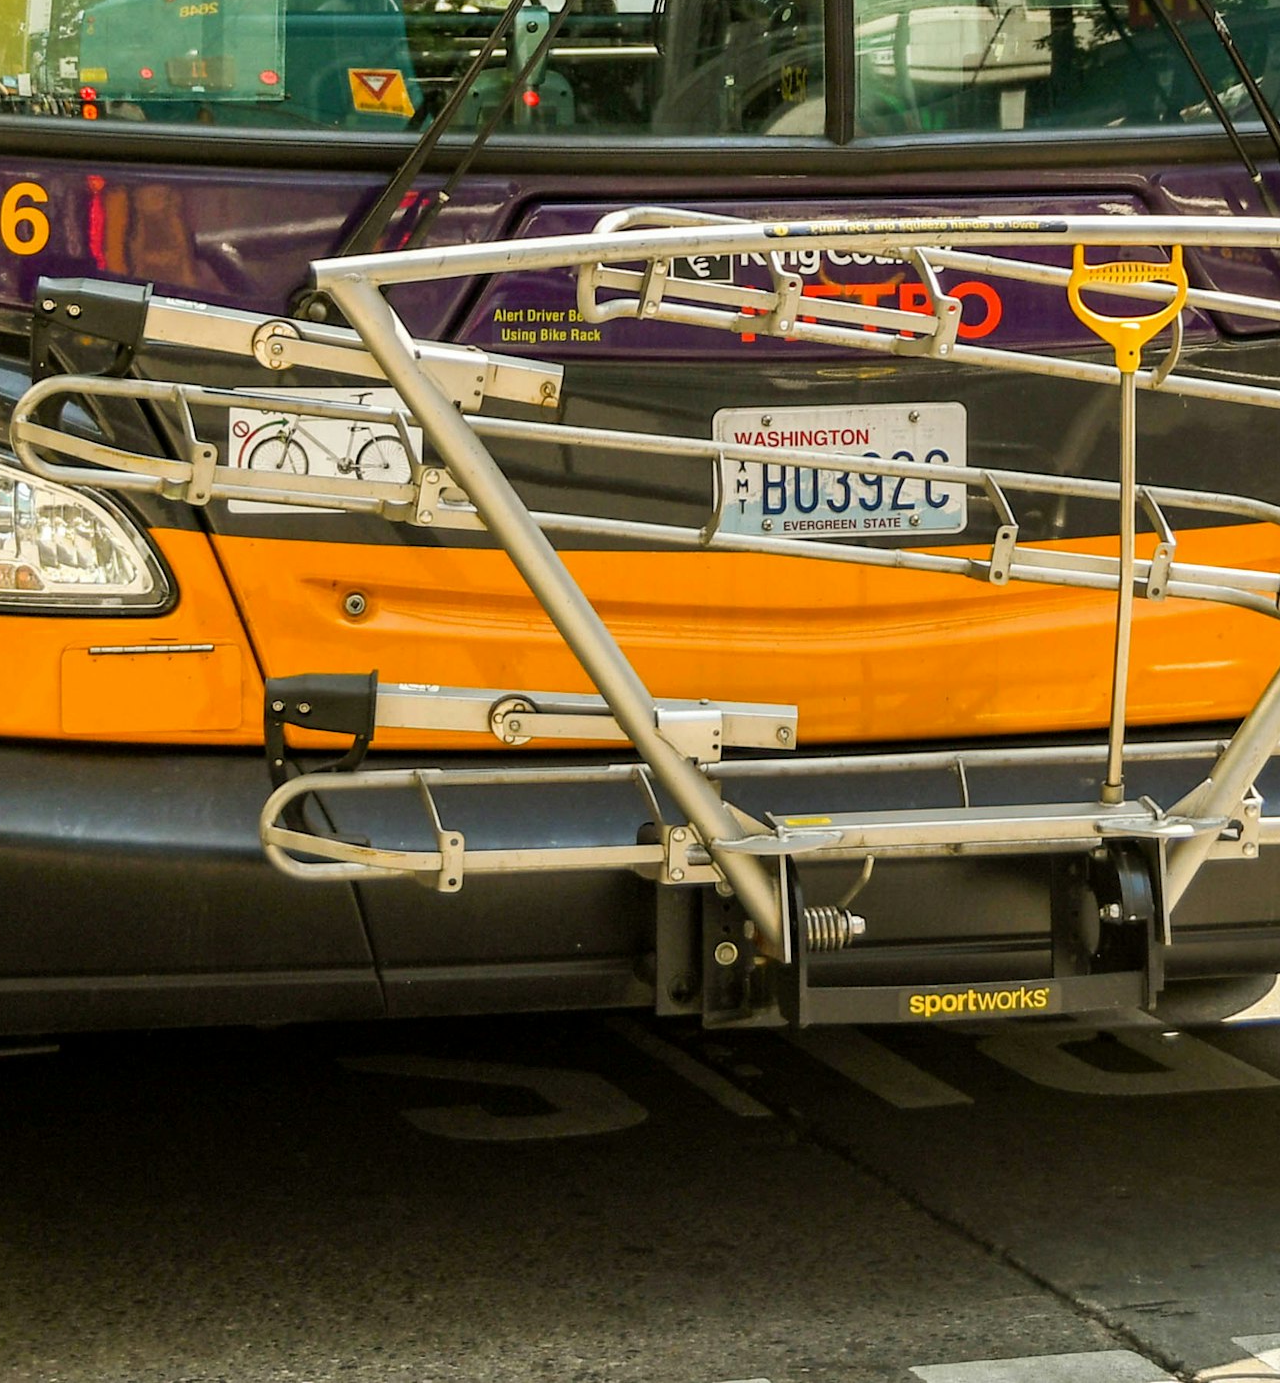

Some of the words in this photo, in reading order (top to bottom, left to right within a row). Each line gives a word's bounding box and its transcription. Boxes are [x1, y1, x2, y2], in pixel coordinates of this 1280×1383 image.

[494, 309, 523, 321] Alert
[527, 309, 565, 322] Driver
[501, 328, 537, 344] Using
[540, 328, 567, 341] Bike
[571, 328, 601, 341] Rack
[734, 428, 870, 448] WASHINGTON
[783, 519, 857, 532] EVERGREEN
[863, 517, 902, 529] STATE
[909, 987, 1049, 1017] sportworks
